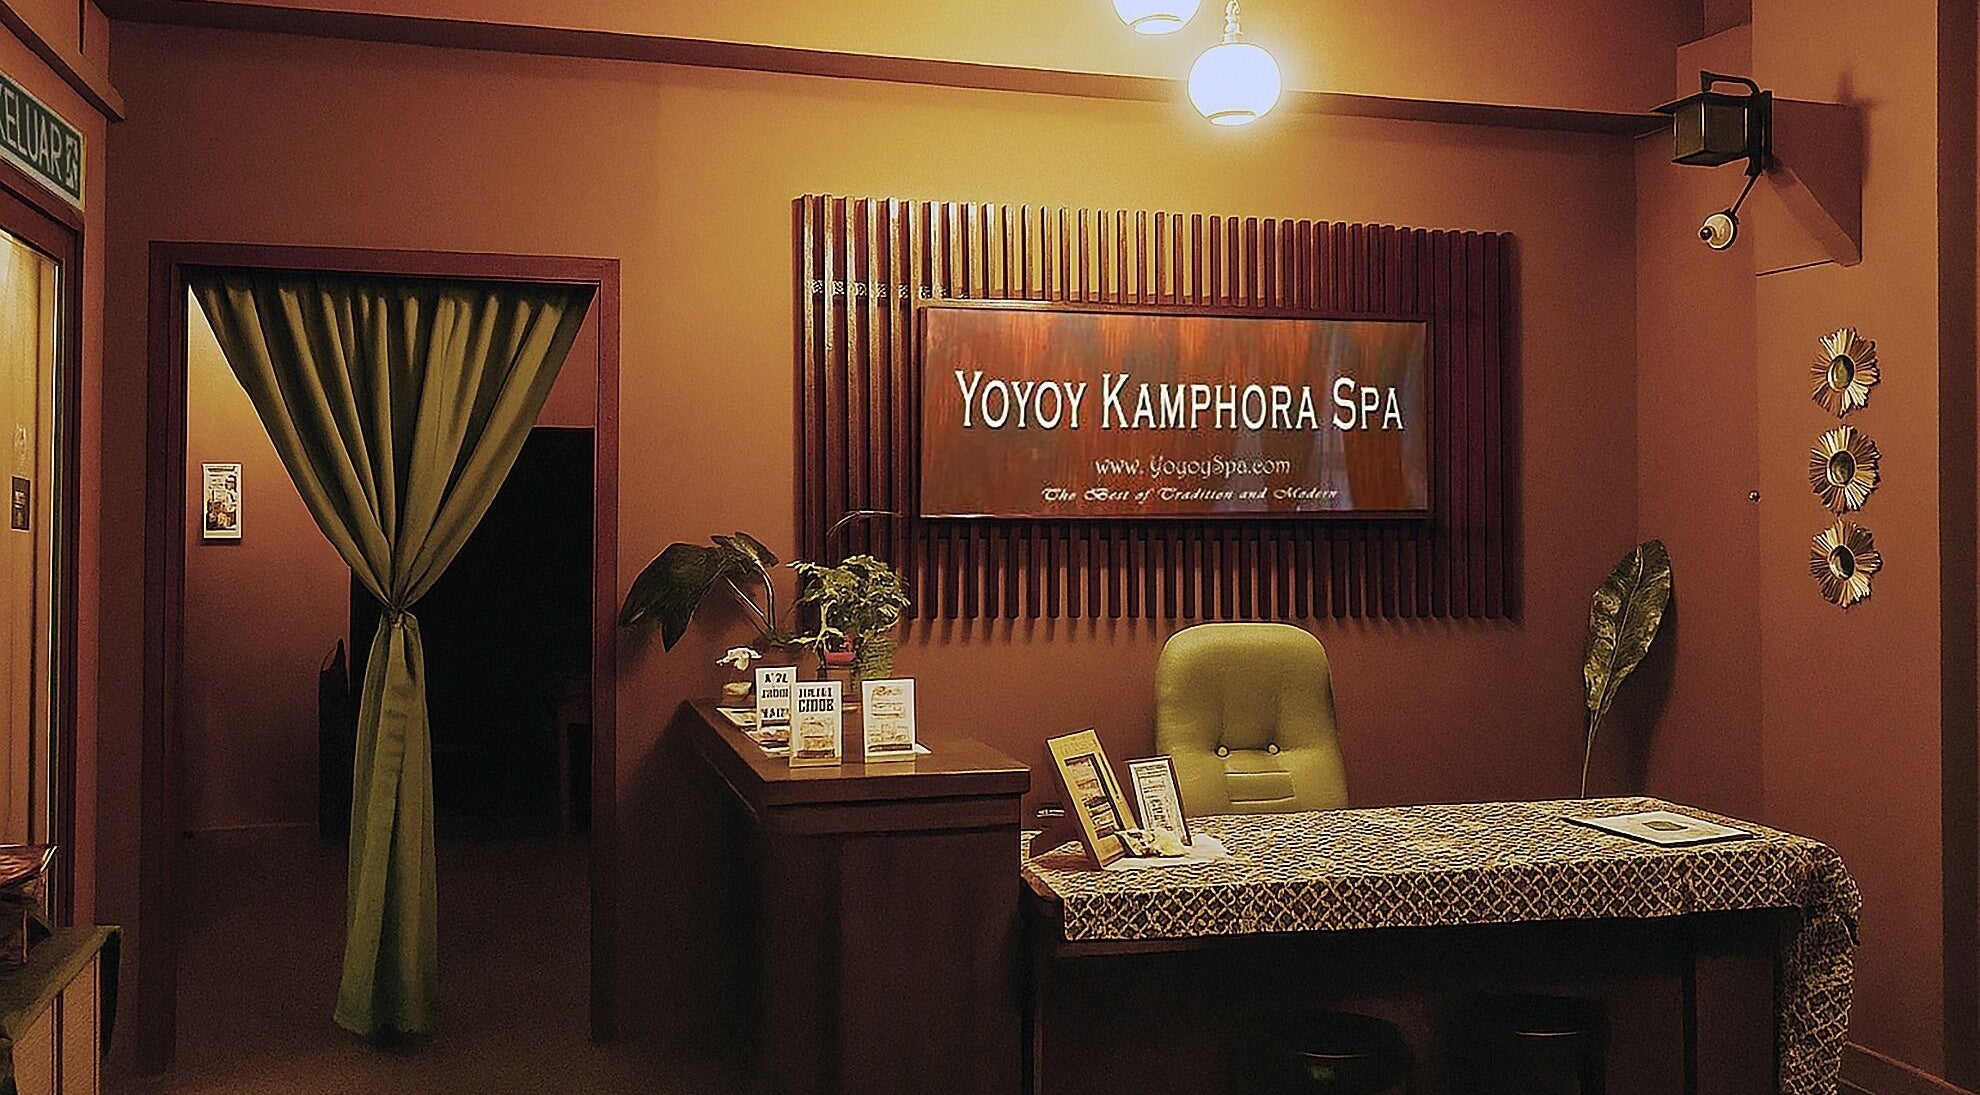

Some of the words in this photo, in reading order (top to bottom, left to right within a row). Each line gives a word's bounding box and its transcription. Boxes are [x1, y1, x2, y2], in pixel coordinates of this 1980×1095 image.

[954, 370, 1087, 429] YOYOY
[1101, 373, 1319, 430] KAMPHORA
[1332, 377, 1403, 430] SPA
[1041, 486, 1077, 501] The
[1083, 486, 1130, 501] Best
[1134, 488, 1154, 505] of
[1157, 486, 1233, 501] Tradition
[1238, 486, 1268, 500] and
[1273, 486, 1339, 500] Modern
